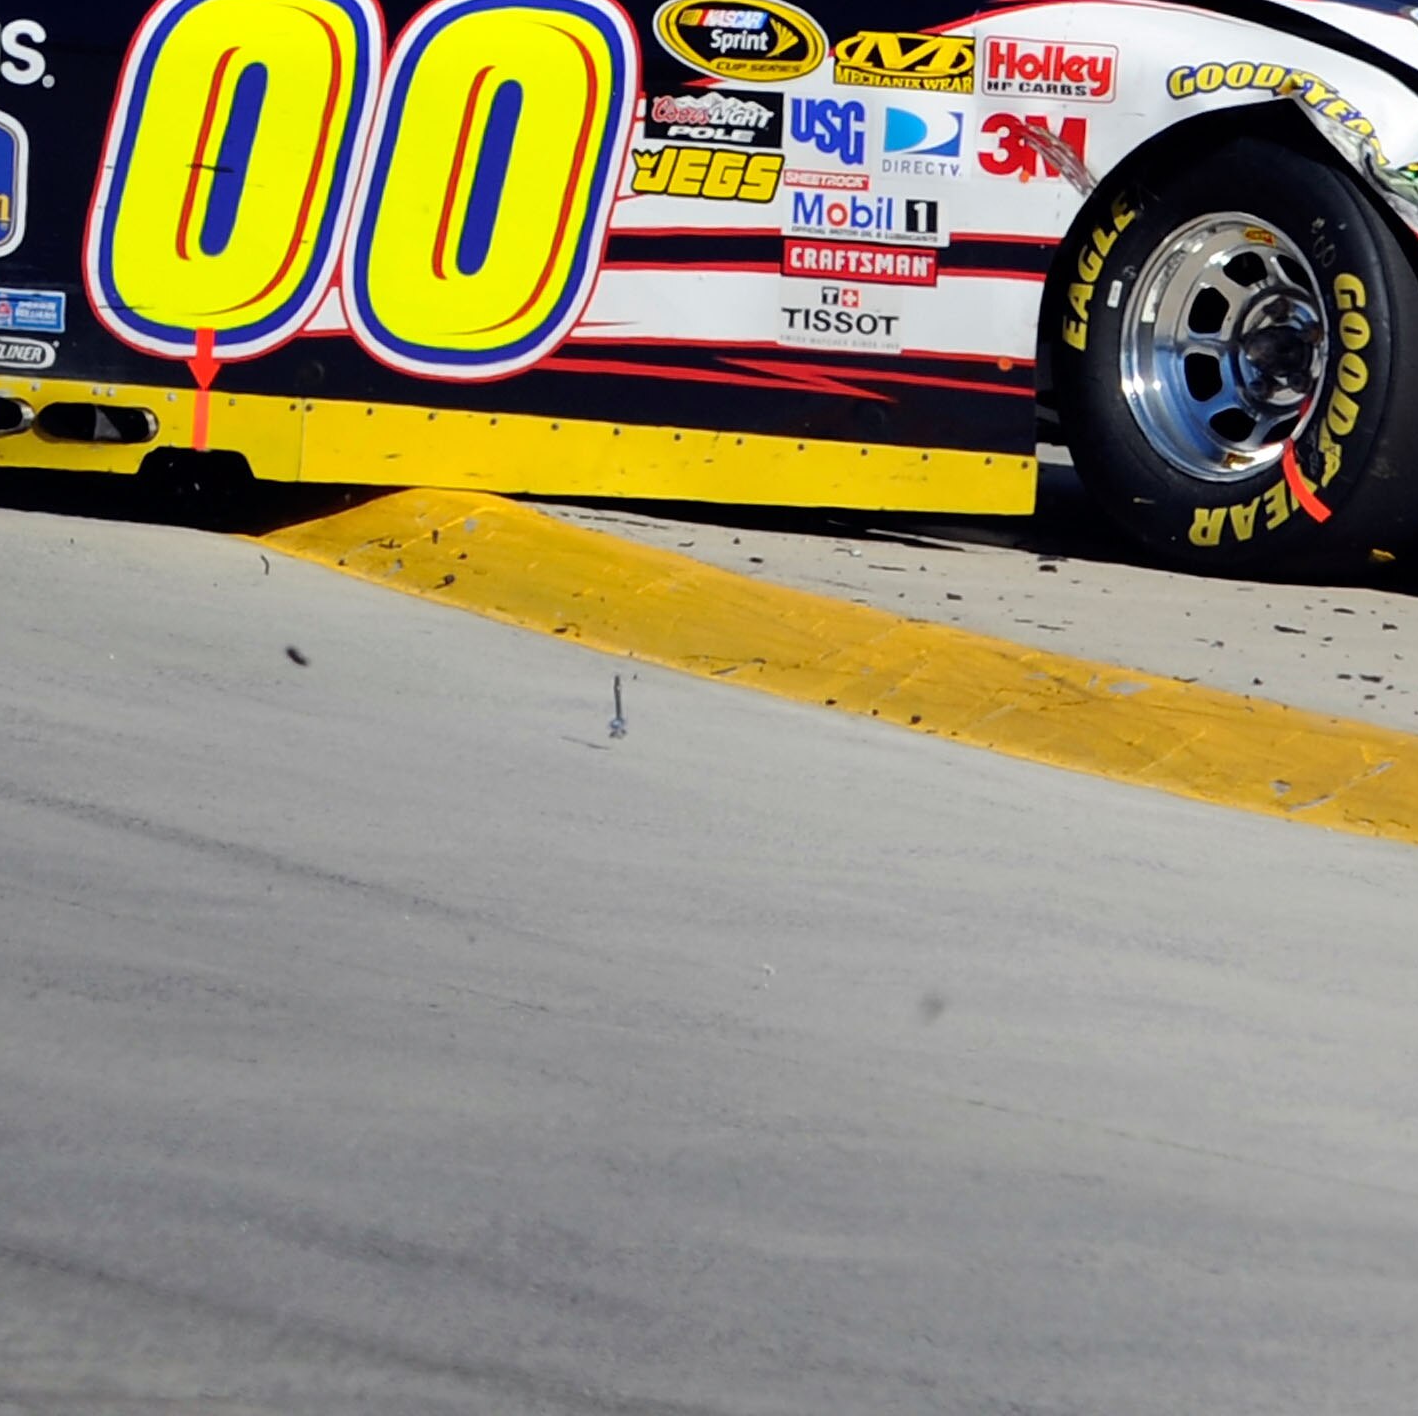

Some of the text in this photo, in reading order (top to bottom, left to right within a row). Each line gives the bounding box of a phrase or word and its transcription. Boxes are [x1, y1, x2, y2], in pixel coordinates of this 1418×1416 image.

[702, 9, 764, 28] NASCAR
[710, 30, 769, 53] Sprint
[716, 61, 801, 72] CUP SERIES
[835, 66, 973, 93] MECHANIX WEAR
[988, 42, 1112, 96] Holley
[987, 81, 1087, 96] HP CARBS
[652, 95, 775, 128] Coors LIGHT
[667, 125, 756, 143] POLE
[790, 98, 866, 166] USG
[978, 113, 1087, 177] 3M
[632, 146, 784, 203] JEGS
[785, 171, 868, 188] SHEETROCK
[882, 159, 959, 176] DIRECTV
[792, 191, 893, 229] Mobil
[790, 247, 930, 277] CRAFTSMAN
[1062, 192, 1138, 351] EAGLE
[782, 307, 899, 336] TISSOT
